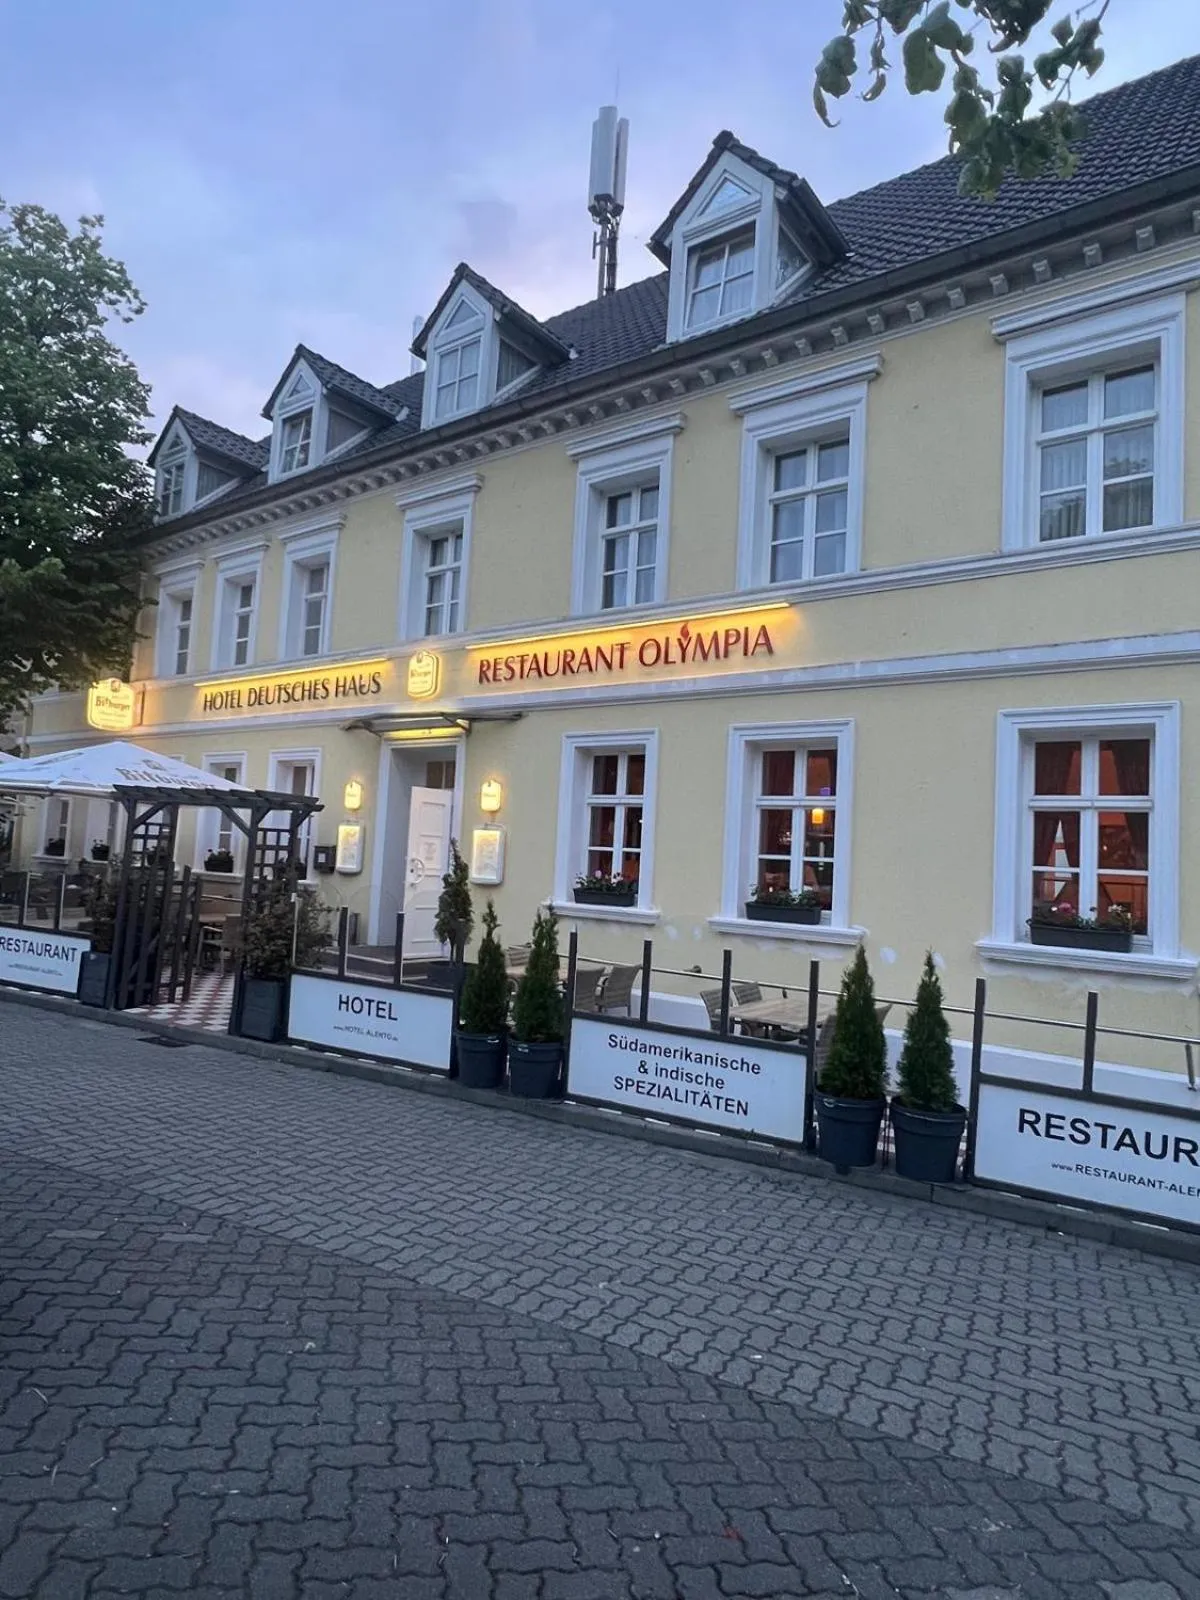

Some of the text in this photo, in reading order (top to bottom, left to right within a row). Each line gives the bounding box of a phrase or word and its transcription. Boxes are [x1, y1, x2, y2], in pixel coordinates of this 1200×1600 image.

[478, 624, 774, 684] RESTAURANT OLYMPIA
[203, 672, 382, 712] HOTEL DEUTSCHES HAUS
[0, 936, 78, 962] RESTAURANT
[338, 994, 398, 1021] HOTEL
[607, 1033, 762, 1075] Südamerikanische
[638, 1059, 725, 1090] & indische
[613, 1075, 749, 1117] SPEZIALITÄTEN
[1018, 1107, 1200, 1168] RESTAUR
